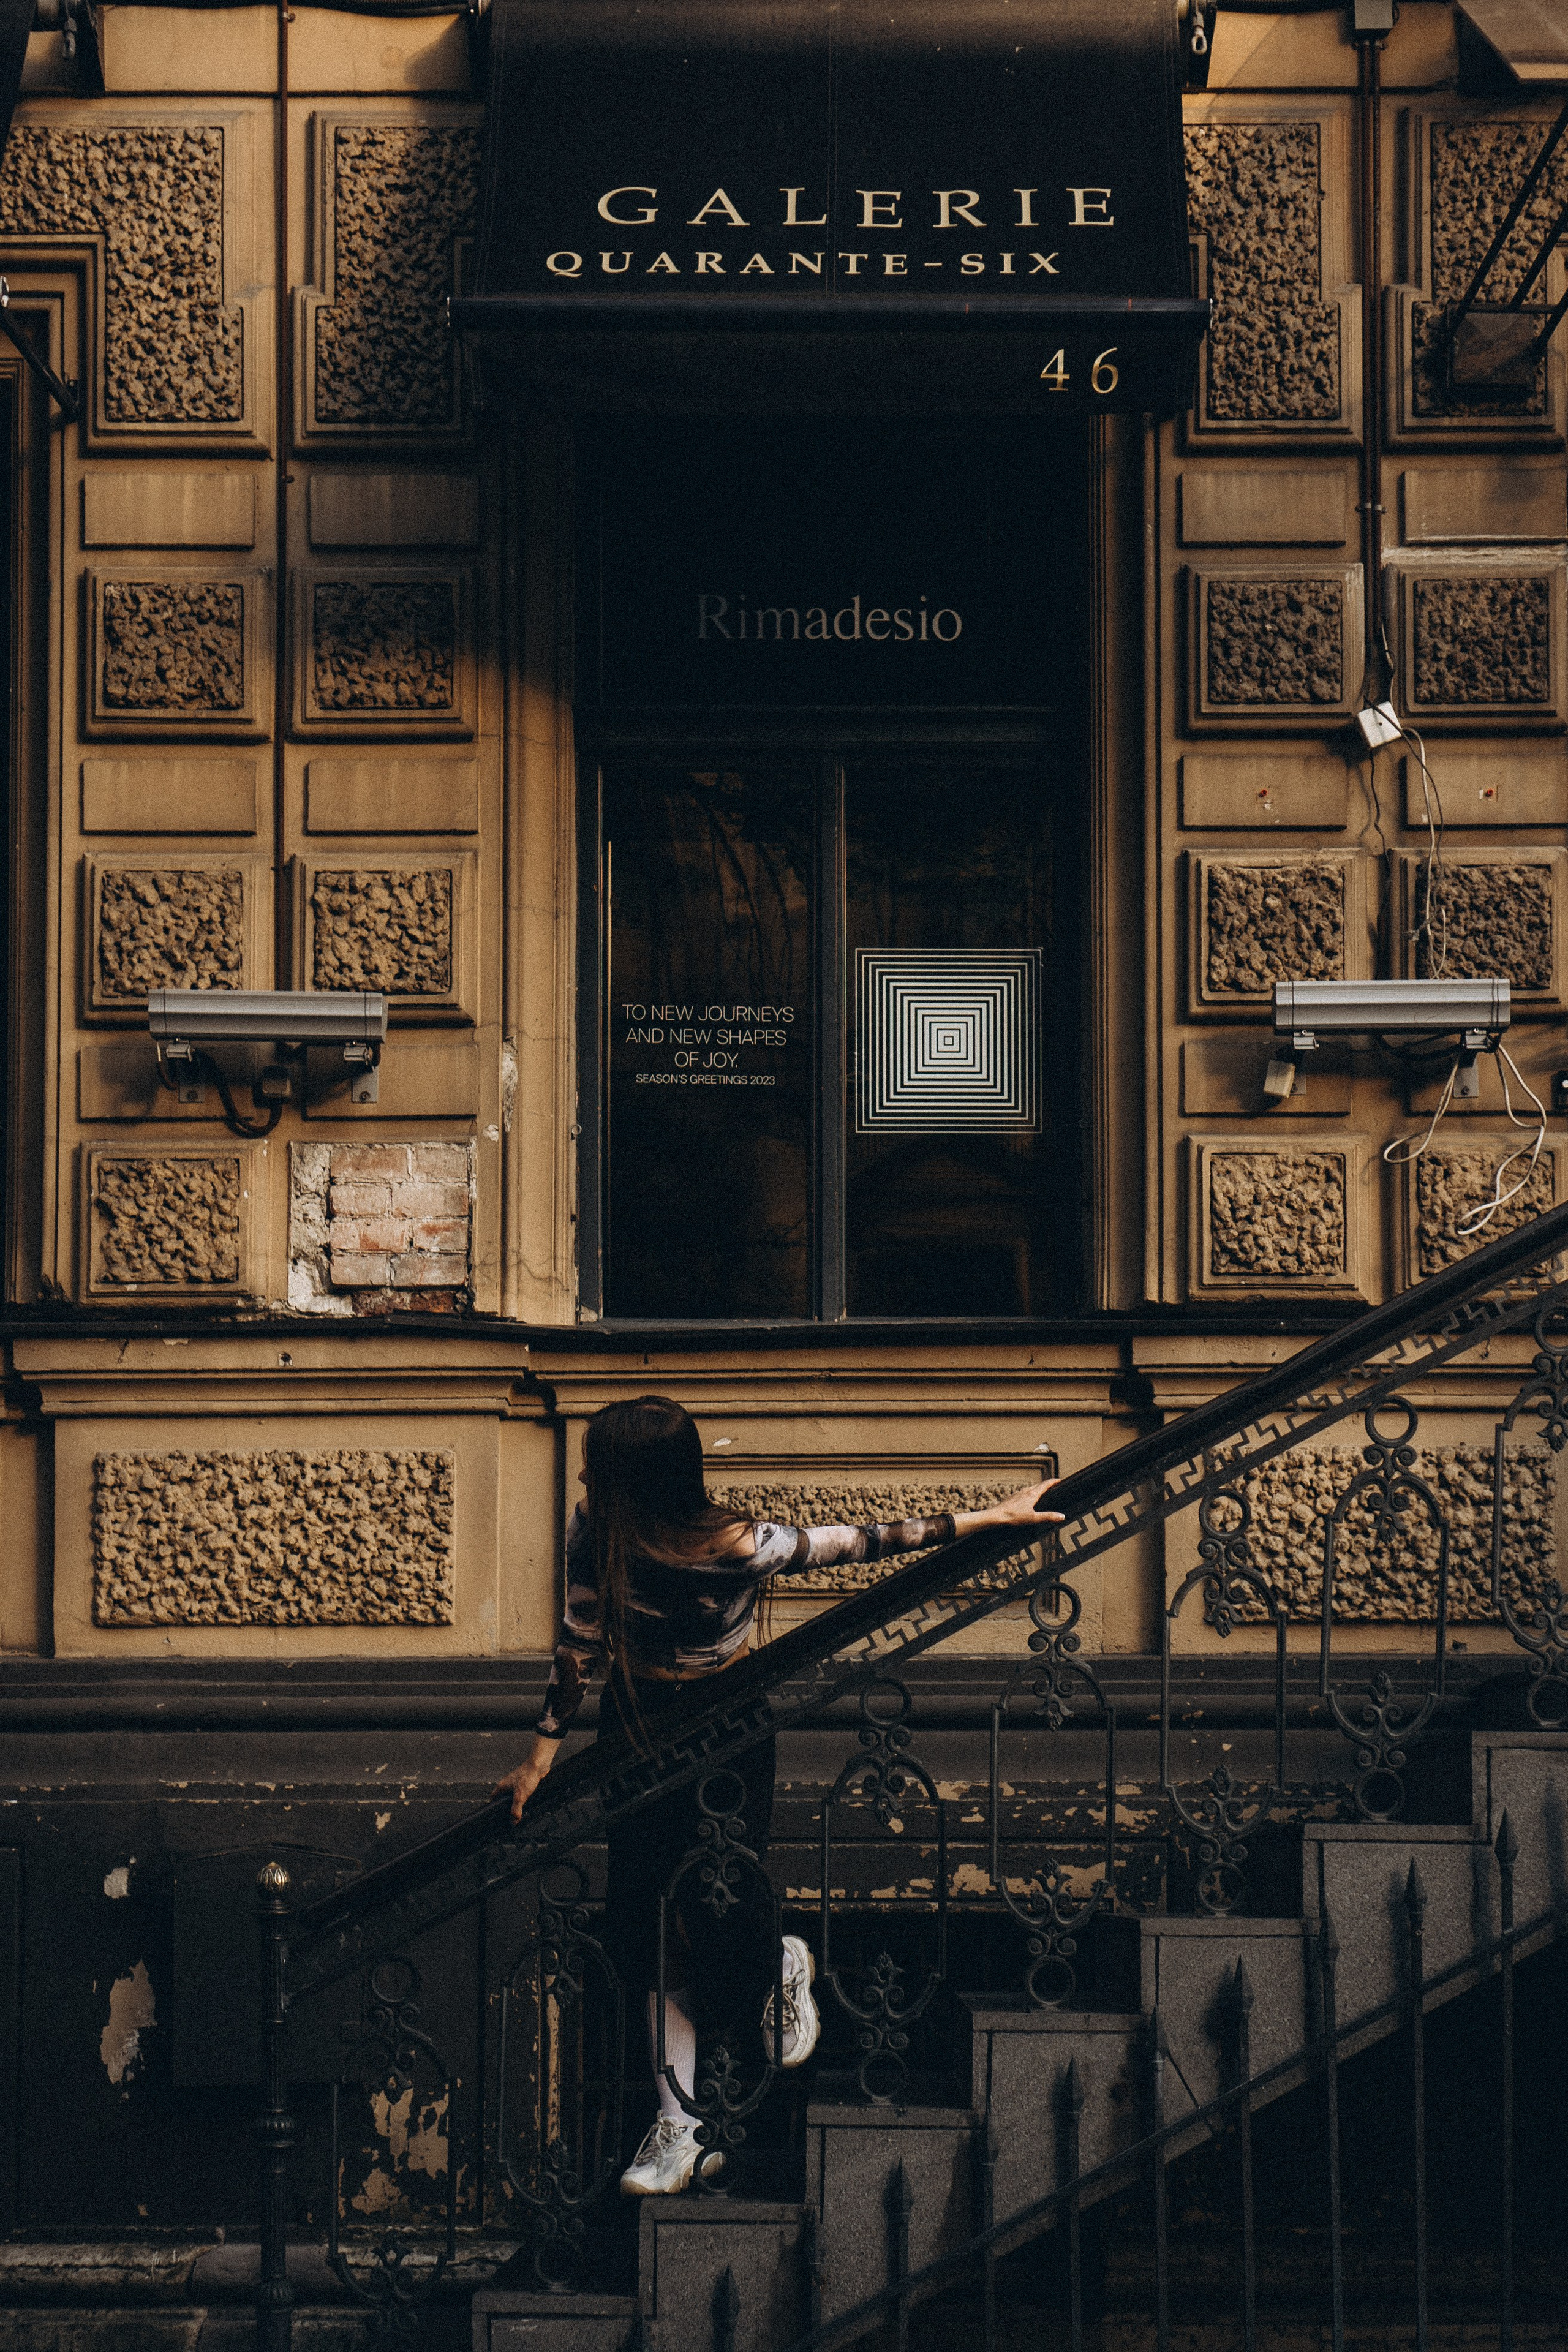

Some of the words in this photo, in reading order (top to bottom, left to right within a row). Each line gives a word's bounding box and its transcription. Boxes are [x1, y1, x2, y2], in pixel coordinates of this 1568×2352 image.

[597, 186, 1115, 229] GALERIE
[546, 251, 1061, 277] QUARANTE-SIX
[1039, 347, 1120, 394] 46
[697, 594, 963, 641] Rimadesio
[622, 1005, 646, 1020] TO
[652, 1005, 694, 1021] NEW
[698, 1006, 794, 1022] JOURNEYS
[625, 1028, 664, 1044] AND
[669, 1029, 712, 1044] NEW
[717, 1029, 787, 1046] SHAPES
[674, 1052, 699, 1068] OF
[703, 1052, 738, 1068] JOY.
[636, 1074, 687, 1084] SEASON'S
[690, 1074, 747, 1085] GREETINGS
[750, 1076, 775, 1085] 2023
